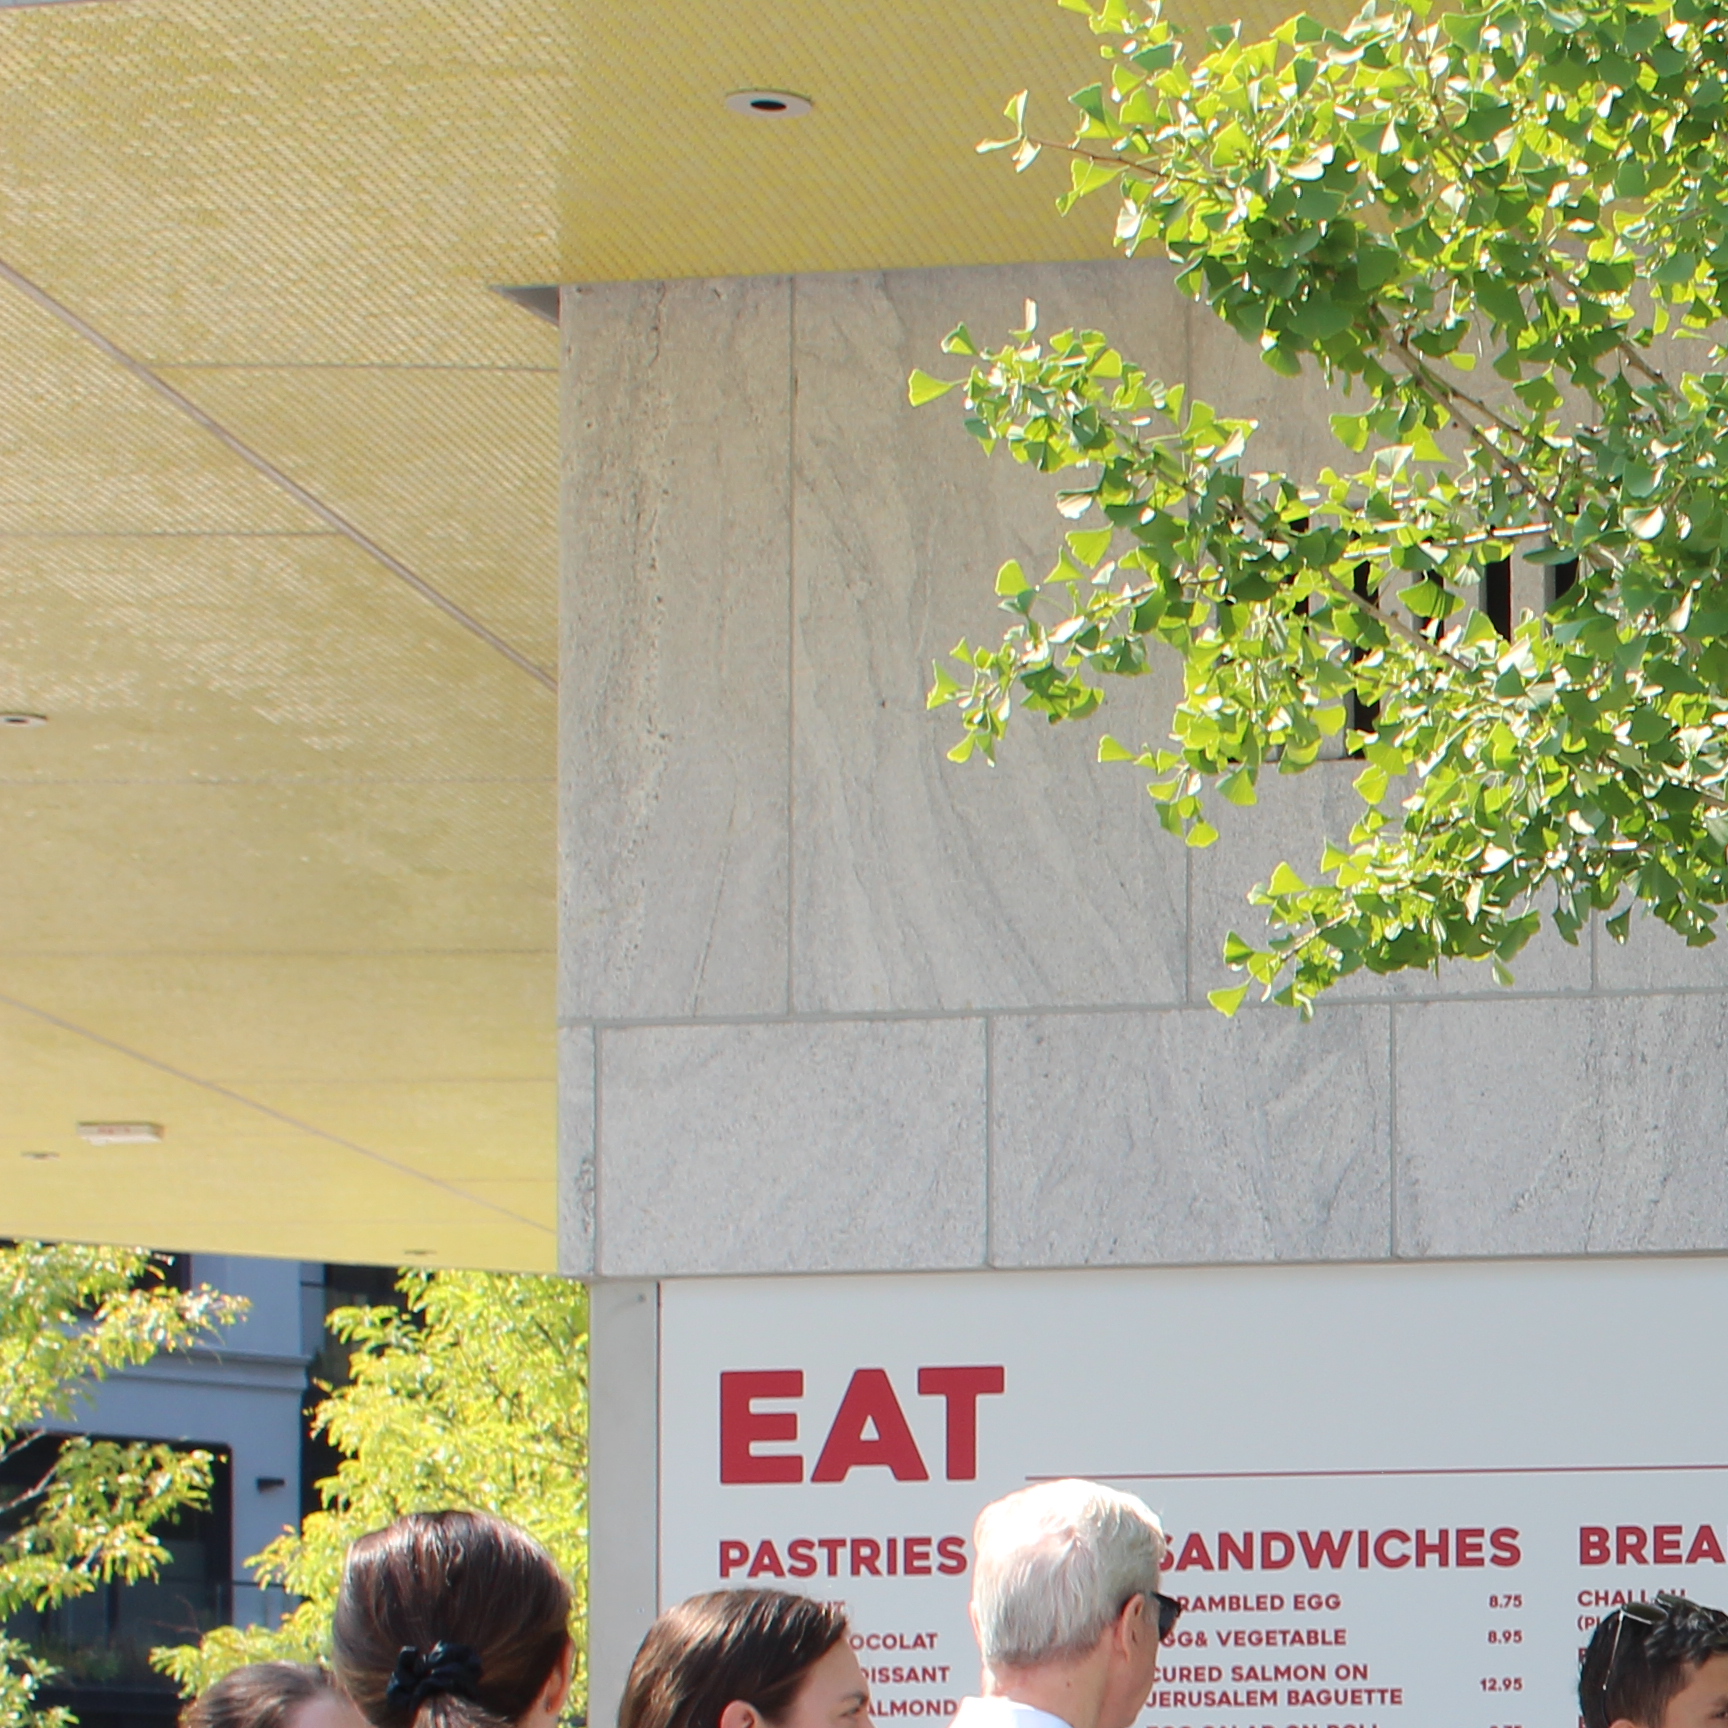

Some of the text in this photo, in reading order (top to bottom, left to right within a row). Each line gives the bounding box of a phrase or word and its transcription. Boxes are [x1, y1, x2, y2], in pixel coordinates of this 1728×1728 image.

[719, 1365, 1005, 1485] EAT
[719, 1535, 968, 1579] PASTRIES
[1180, 1593, 1523, 1611] RAMBLED EGG 8.75
[1577, 1589, 1687, 1607] CHALL
[1160, 1628, 1523, 1648] GG& VEGETABLE 8.95
[1231, 1664, 1326, 1683] SALMON
[1334, 1663, 1368, 1681] ON
[1480, 1677, 1523, 1692] 12.95
[1145, 1688, 1403, 1708] JERUSALEM BAGUETTE
